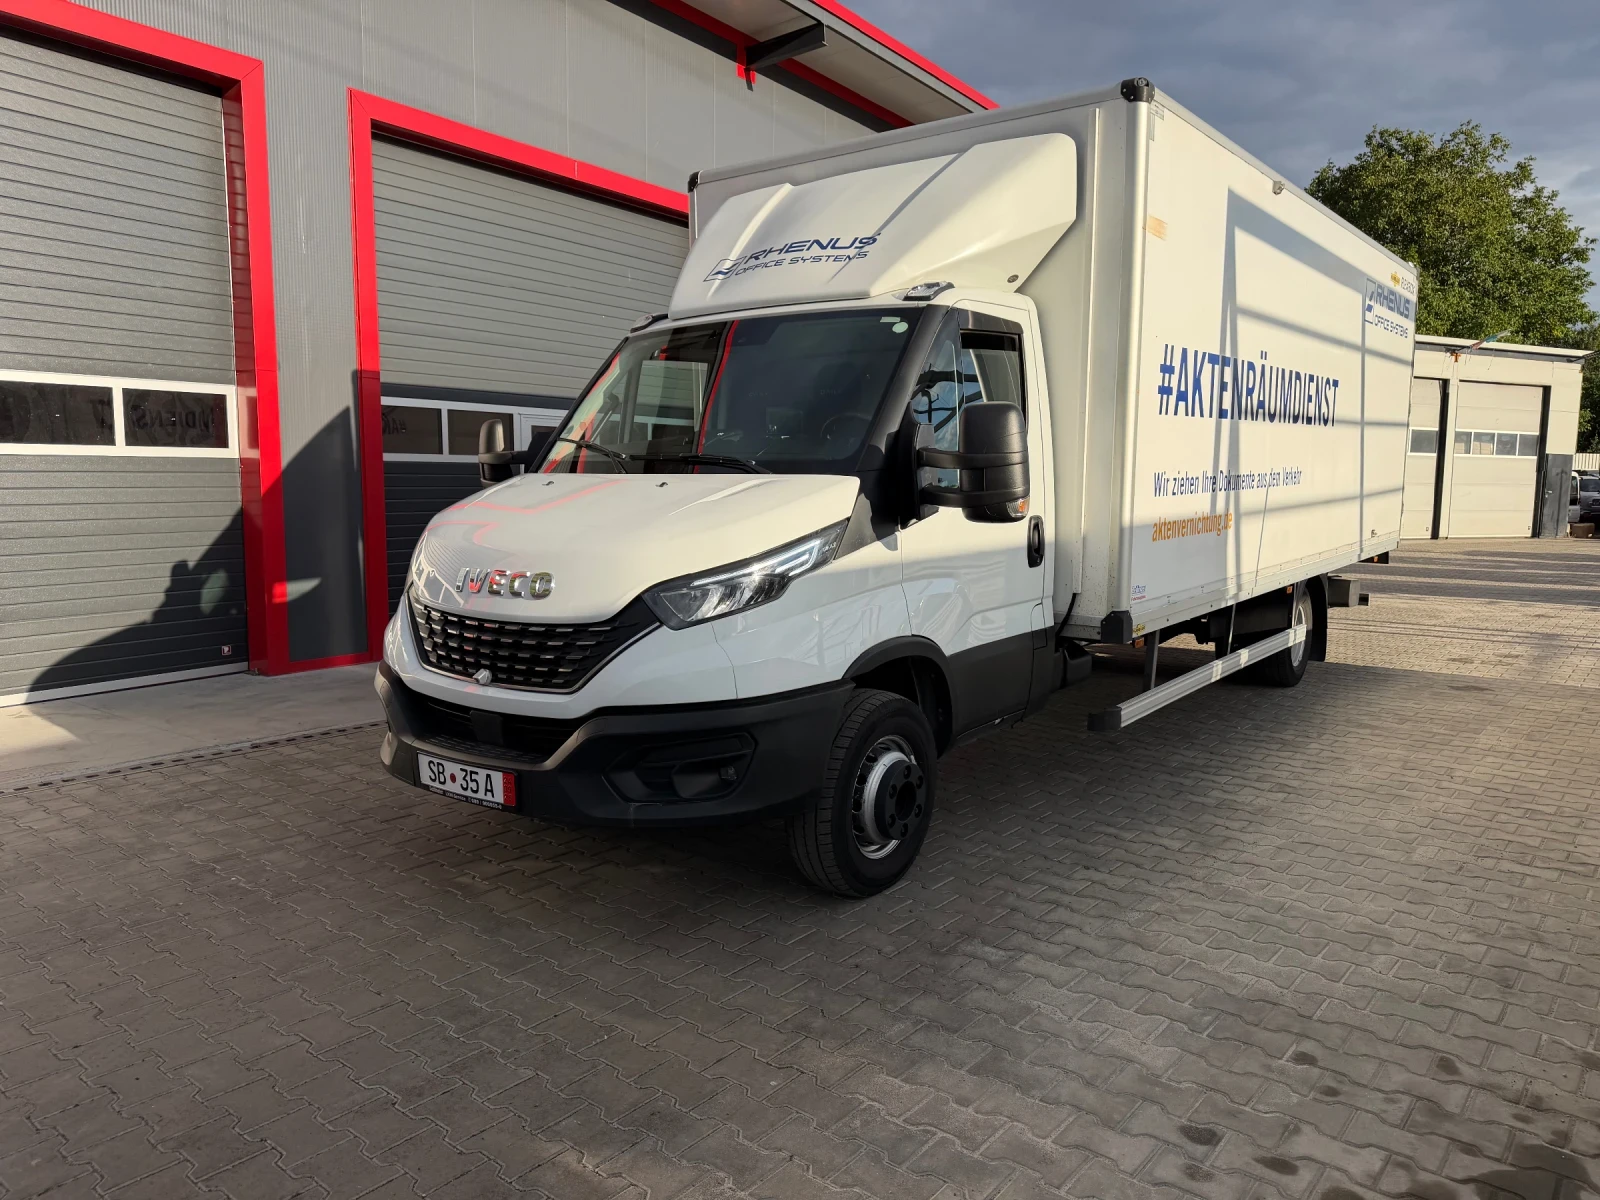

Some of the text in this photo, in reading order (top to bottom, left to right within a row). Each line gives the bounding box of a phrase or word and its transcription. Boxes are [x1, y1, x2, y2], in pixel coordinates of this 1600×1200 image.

[735, 251, 869, 276] OFFICE SYSTEMS
[745, 233, 881, 264] RHENUS
[1376, 283, 1410, 319] RHENUS
[1158, 344, 1339, 427] #AKTENRÄUMDIENST
[1154, 466, 1302, 497] Wir ziehen Ihre Dokumente aus dem Verkehr
[1152, 508, 1233, 542] aktenvernichtung.de
[455, 568, 555, 600] IVECO
[428, 760, 446, 785] SB
[460, 768, 479, 794] 35
[484, 773, 495, 798] A
